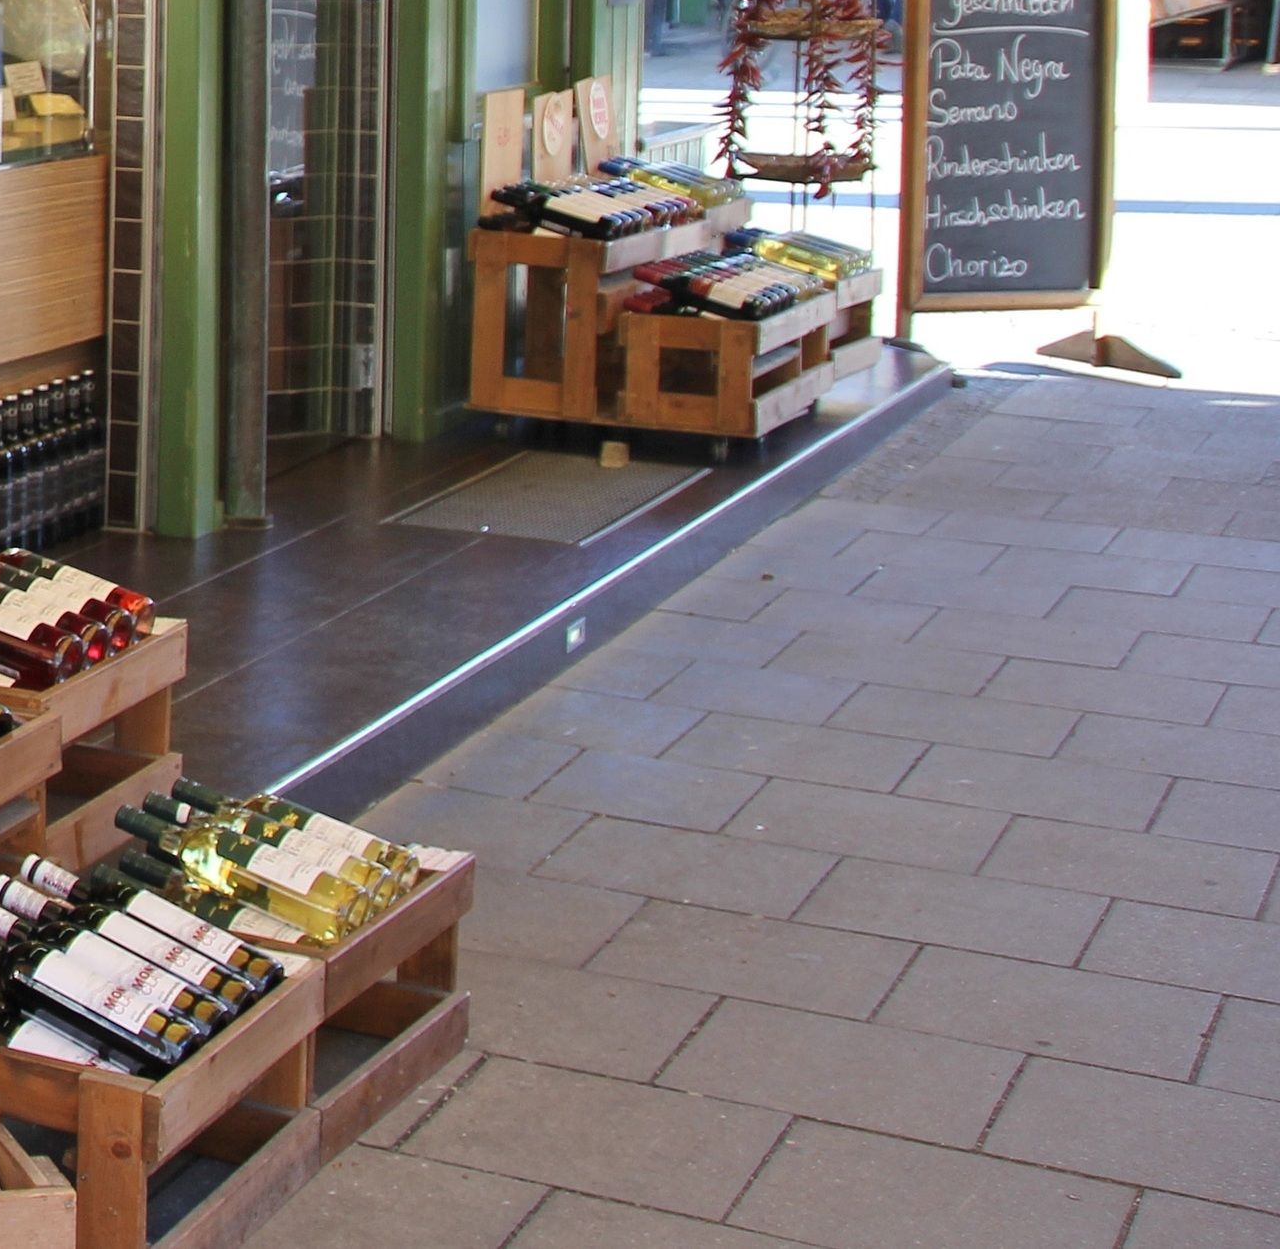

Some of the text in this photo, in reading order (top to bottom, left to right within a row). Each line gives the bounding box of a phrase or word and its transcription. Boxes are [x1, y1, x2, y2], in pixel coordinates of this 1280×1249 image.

[930, 34, 1071, 99] Pata Negra
[926, 88, 1017, 128] Serrano
[926, 131, 1081, 183] Rinderschinken
[924, 186, 1086, 230] Hirschschinken
[926, 242, 1028, 284] Chorizo
